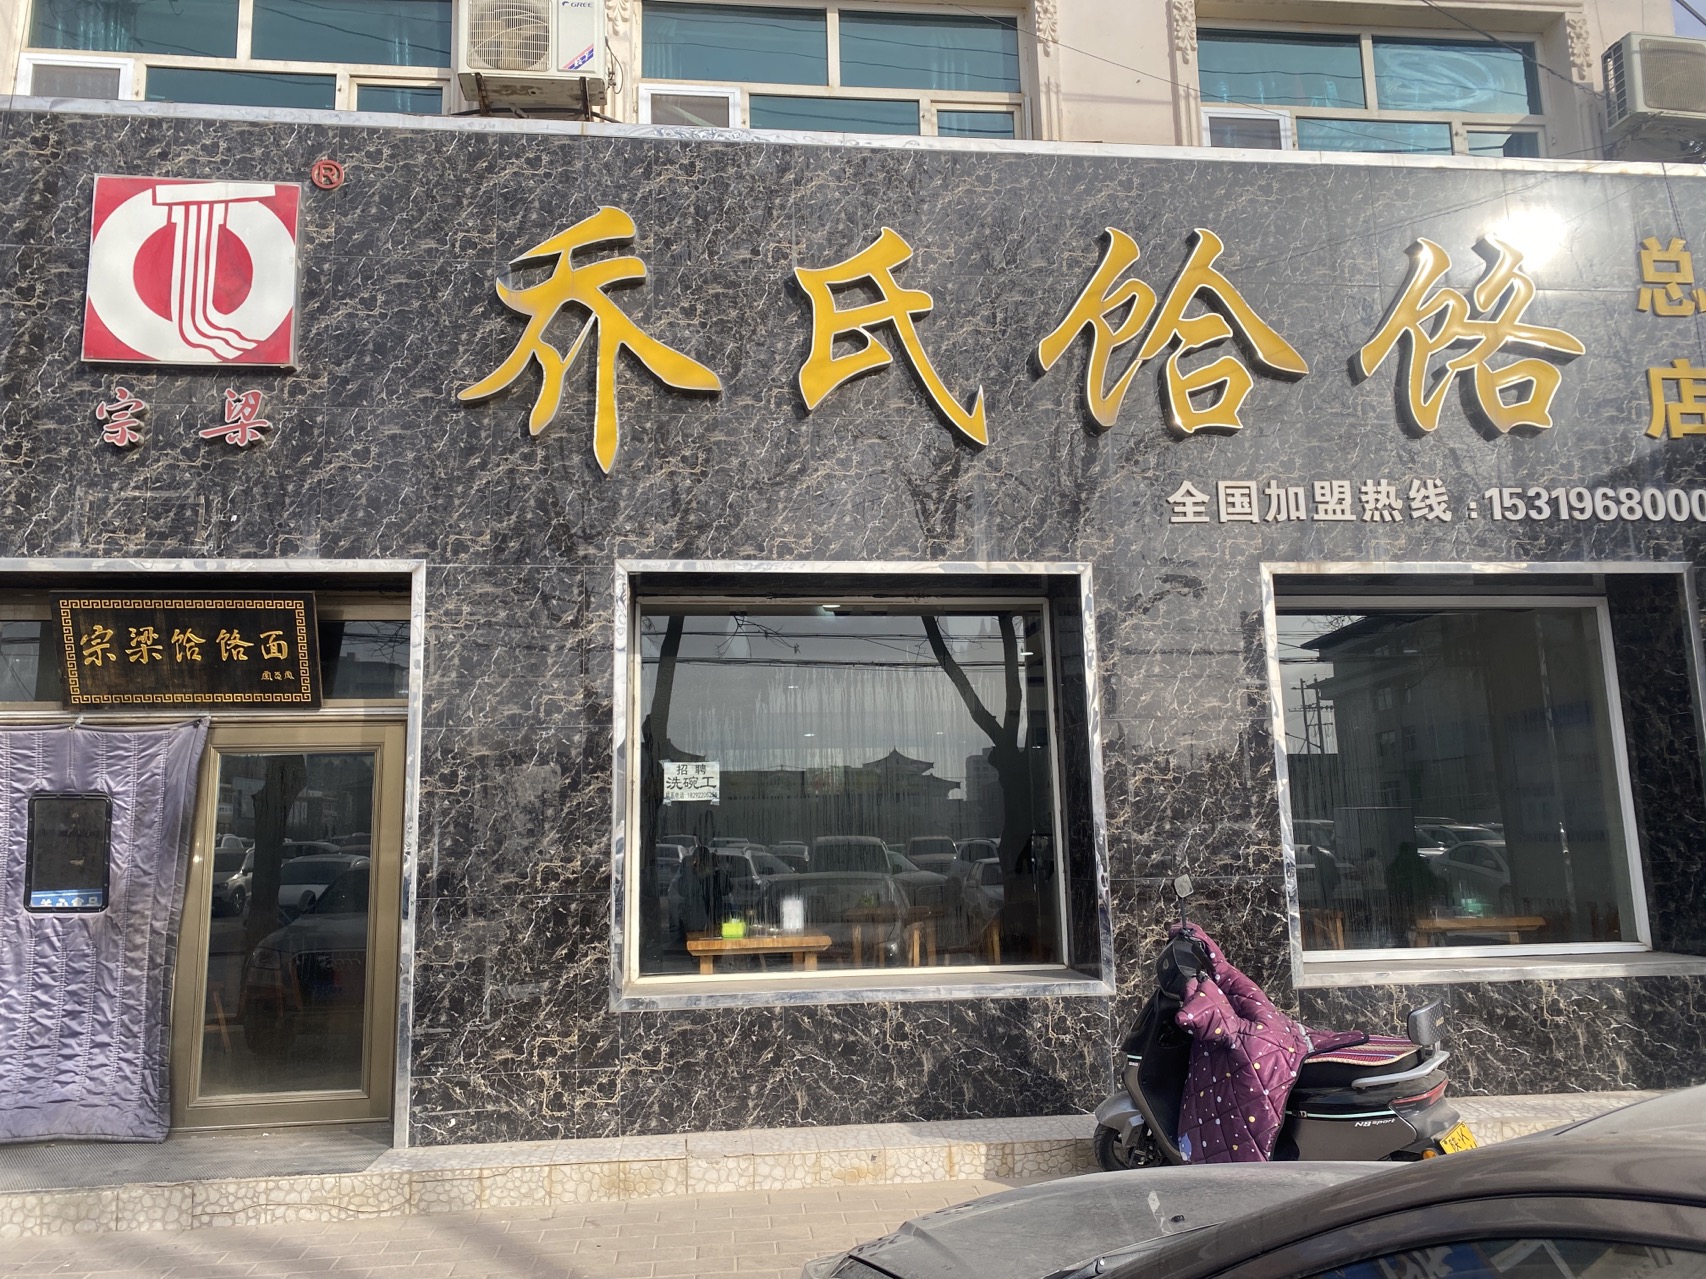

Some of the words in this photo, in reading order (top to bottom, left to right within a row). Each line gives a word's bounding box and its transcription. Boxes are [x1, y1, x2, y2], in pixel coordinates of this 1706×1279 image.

[457, 206, 1586, 474] 乔氏饸饹
[80, 624, 288, 666] 宗梁饸饹面
[665, 776, 717, 790] 洗碗工
[676, 763, 707, 775] 招聘
